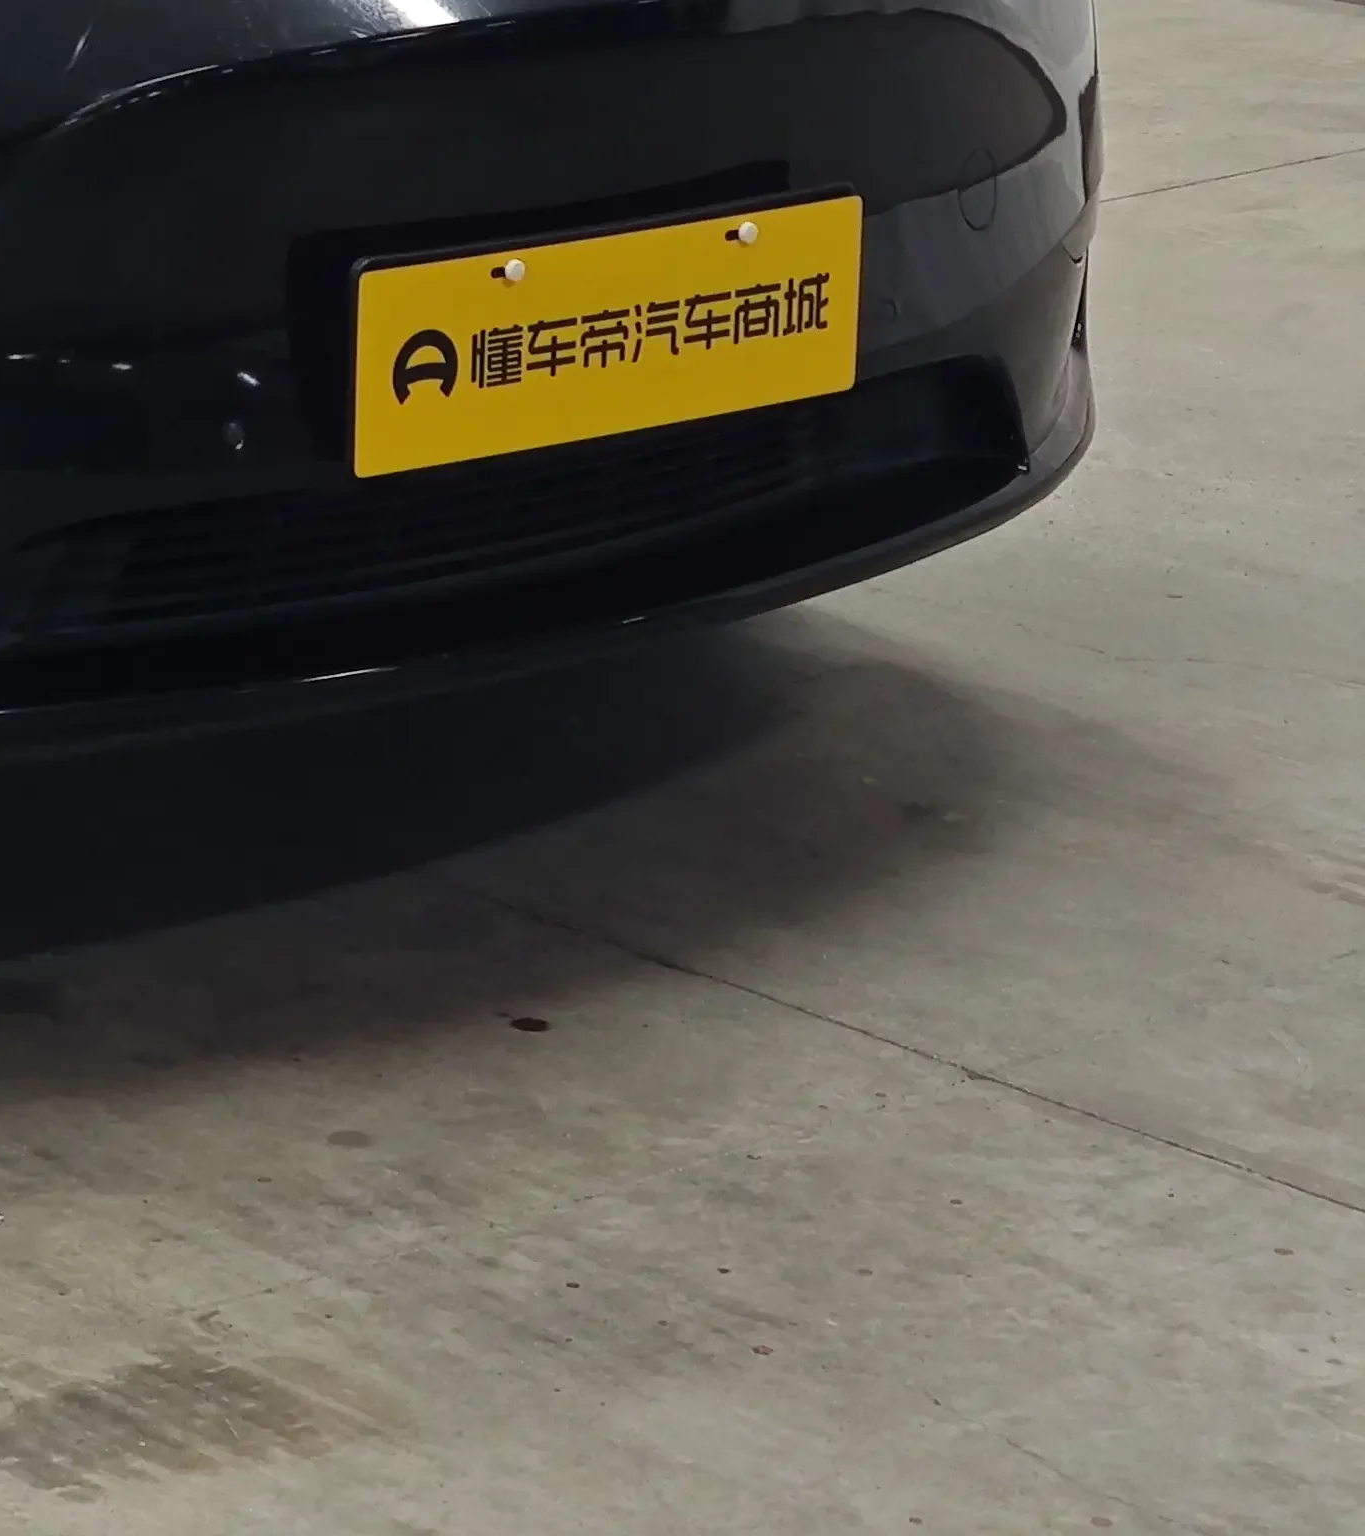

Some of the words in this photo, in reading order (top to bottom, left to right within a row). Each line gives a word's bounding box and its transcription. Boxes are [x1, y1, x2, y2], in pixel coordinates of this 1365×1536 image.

[471, 272, 830, 390] 懂车帝汽车商城
